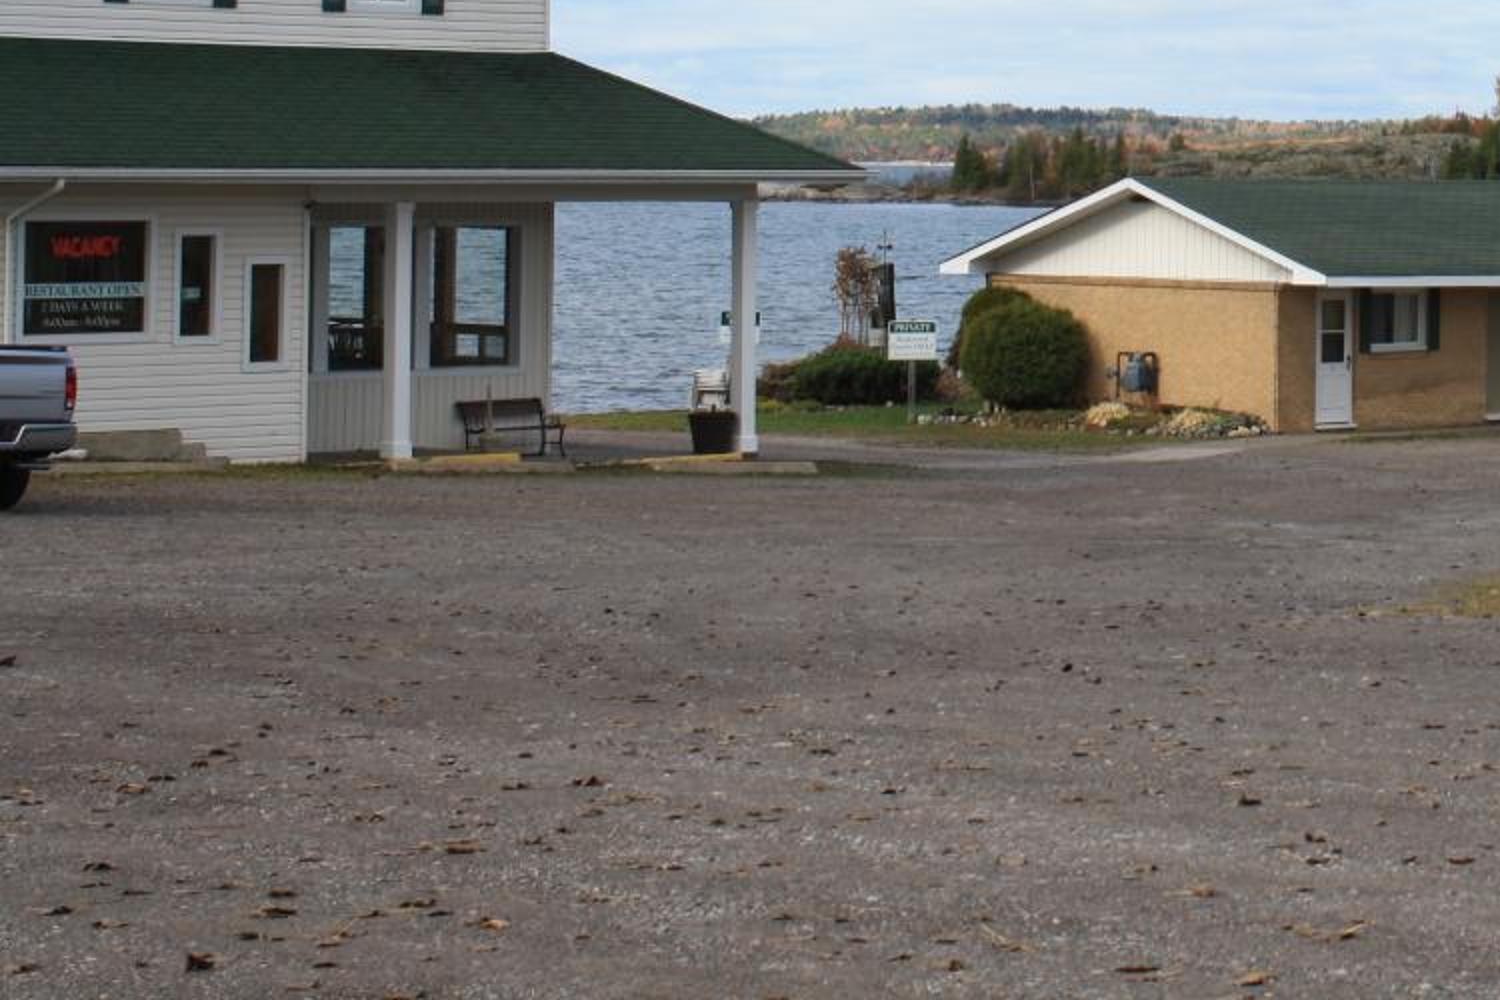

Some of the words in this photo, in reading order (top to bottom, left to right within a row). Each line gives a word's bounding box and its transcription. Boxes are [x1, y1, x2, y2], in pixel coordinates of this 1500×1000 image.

[50, 235, 121, 258] VACANCY
[25, 284, 105, 297] RESTAURANT
[107, 283, 140, 295] OPEN
